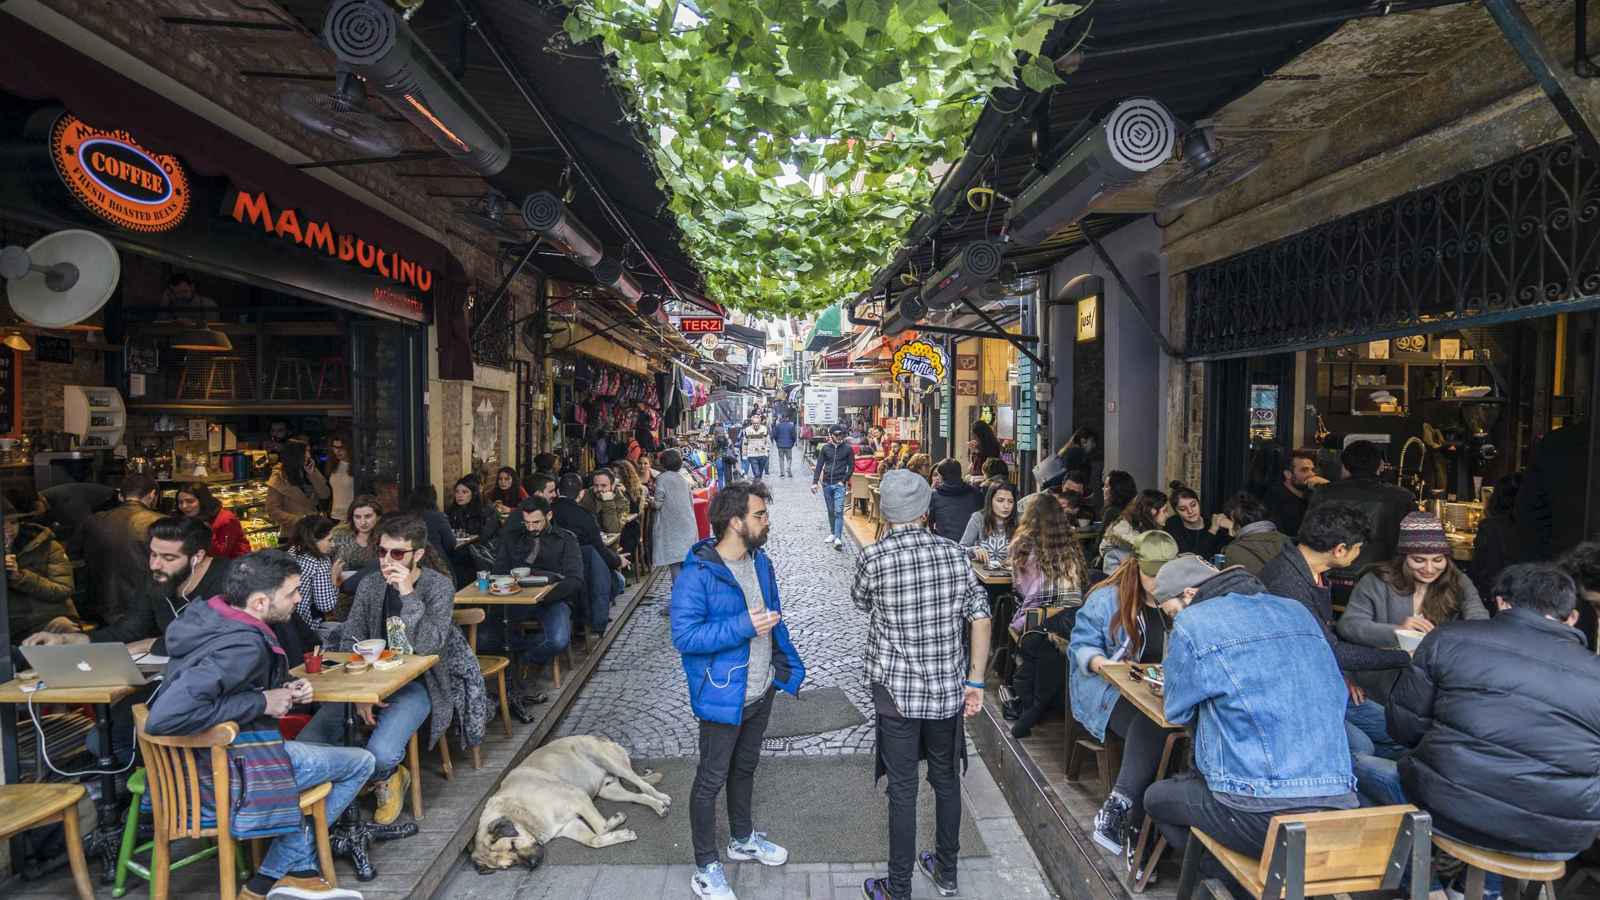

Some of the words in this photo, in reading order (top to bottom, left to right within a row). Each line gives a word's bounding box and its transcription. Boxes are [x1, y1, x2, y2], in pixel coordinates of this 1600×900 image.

[73, 167, 106, 203] FRESH
[109, 200, 152, 221] ROASTED
[91, 152, 163, 194] COFFEE
